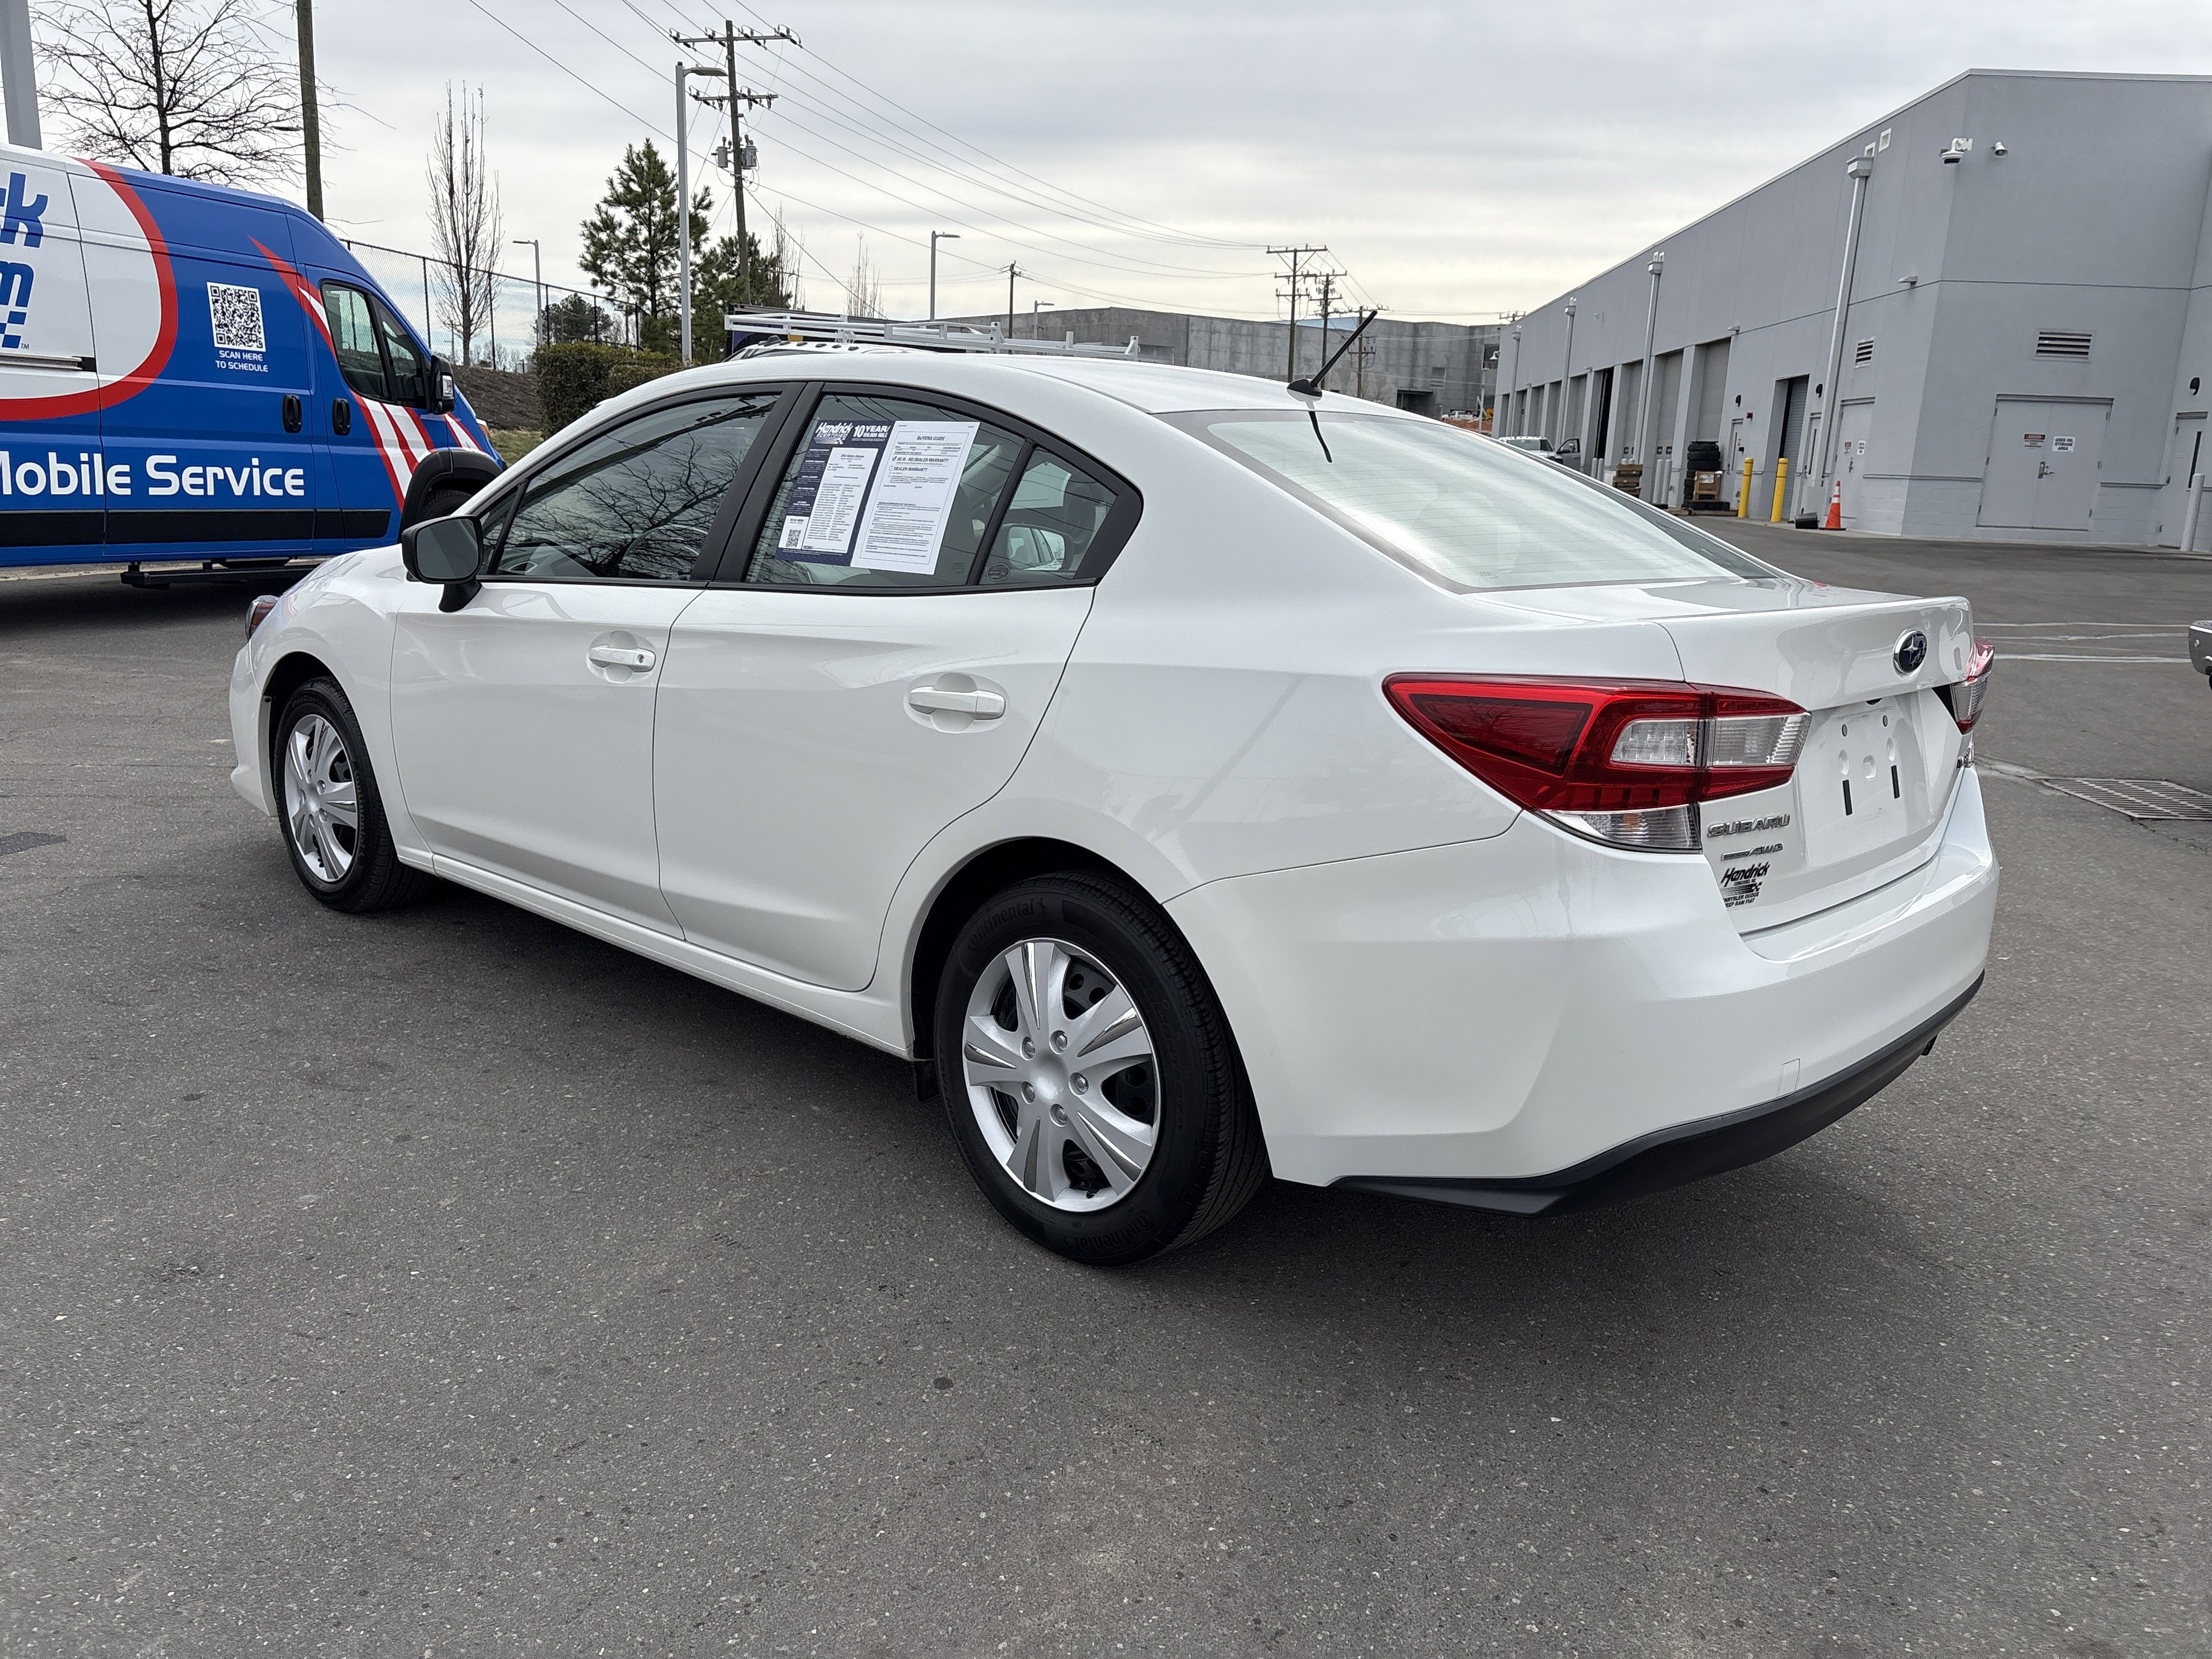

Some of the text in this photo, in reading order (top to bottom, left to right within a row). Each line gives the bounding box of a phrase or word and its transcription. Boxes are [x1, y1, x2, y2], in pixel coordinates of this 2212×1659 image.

[0, 172, 48, 248] k
[219, 349, 263, 362] SCAN HERE
[215, 360, 269, 373] TO SCHEDULE
[815, 422, 854, 438] Hendrick
[853, 425, 866, 438] 10
[146, 455, 306, 496] Service
[1707, 813, 1791, 838] SUBARU
[1747, 843, 1784, 857] AWD
[1720, 861, 1771, 888] Hendrick
